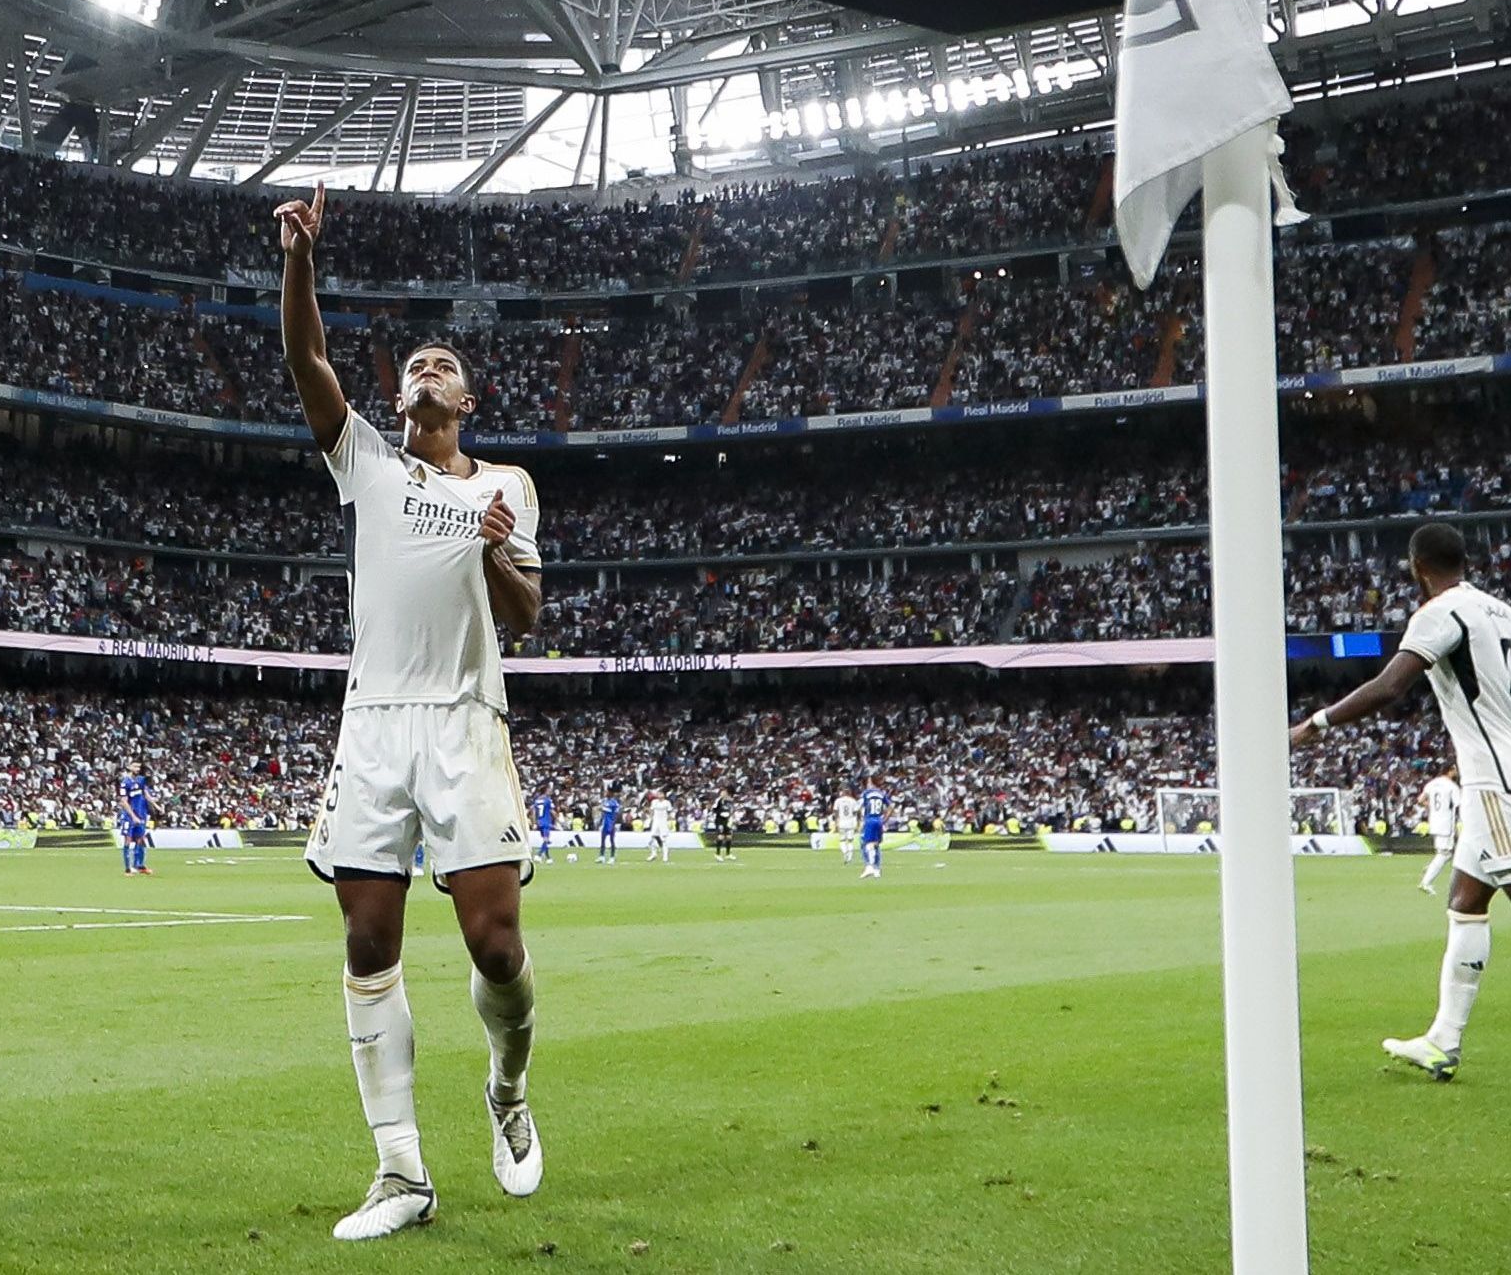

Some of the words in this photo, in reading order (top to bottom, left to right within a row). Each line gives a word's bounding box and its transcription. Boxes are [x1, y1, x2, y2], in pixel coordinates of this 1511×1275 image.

[1277, 375, 1305, 390] adrid
[1095, 396, 1120, 407] Real
[1123, 391, 1164, 405] Madrid
[964, 405, 988, 416] Real
[990, 402, 1029, 415] Madrid
[717, 424, 739, 436] Real
[742, 421, 778, 434] Madrid
[475, 434, 498, 445] Real
[501, 434, 536, 445] Madrid
[403, 496, 488, 526] Emirate
[412, 519, 434, 535] FLY
[112, 639, 142, 658] REAL
[146, 642, 189, 661] MADRID
[615, 656, 649, 673] REAL
[654, 655, 707, 672] MADRID
[870, 798, 883, 815] 18
